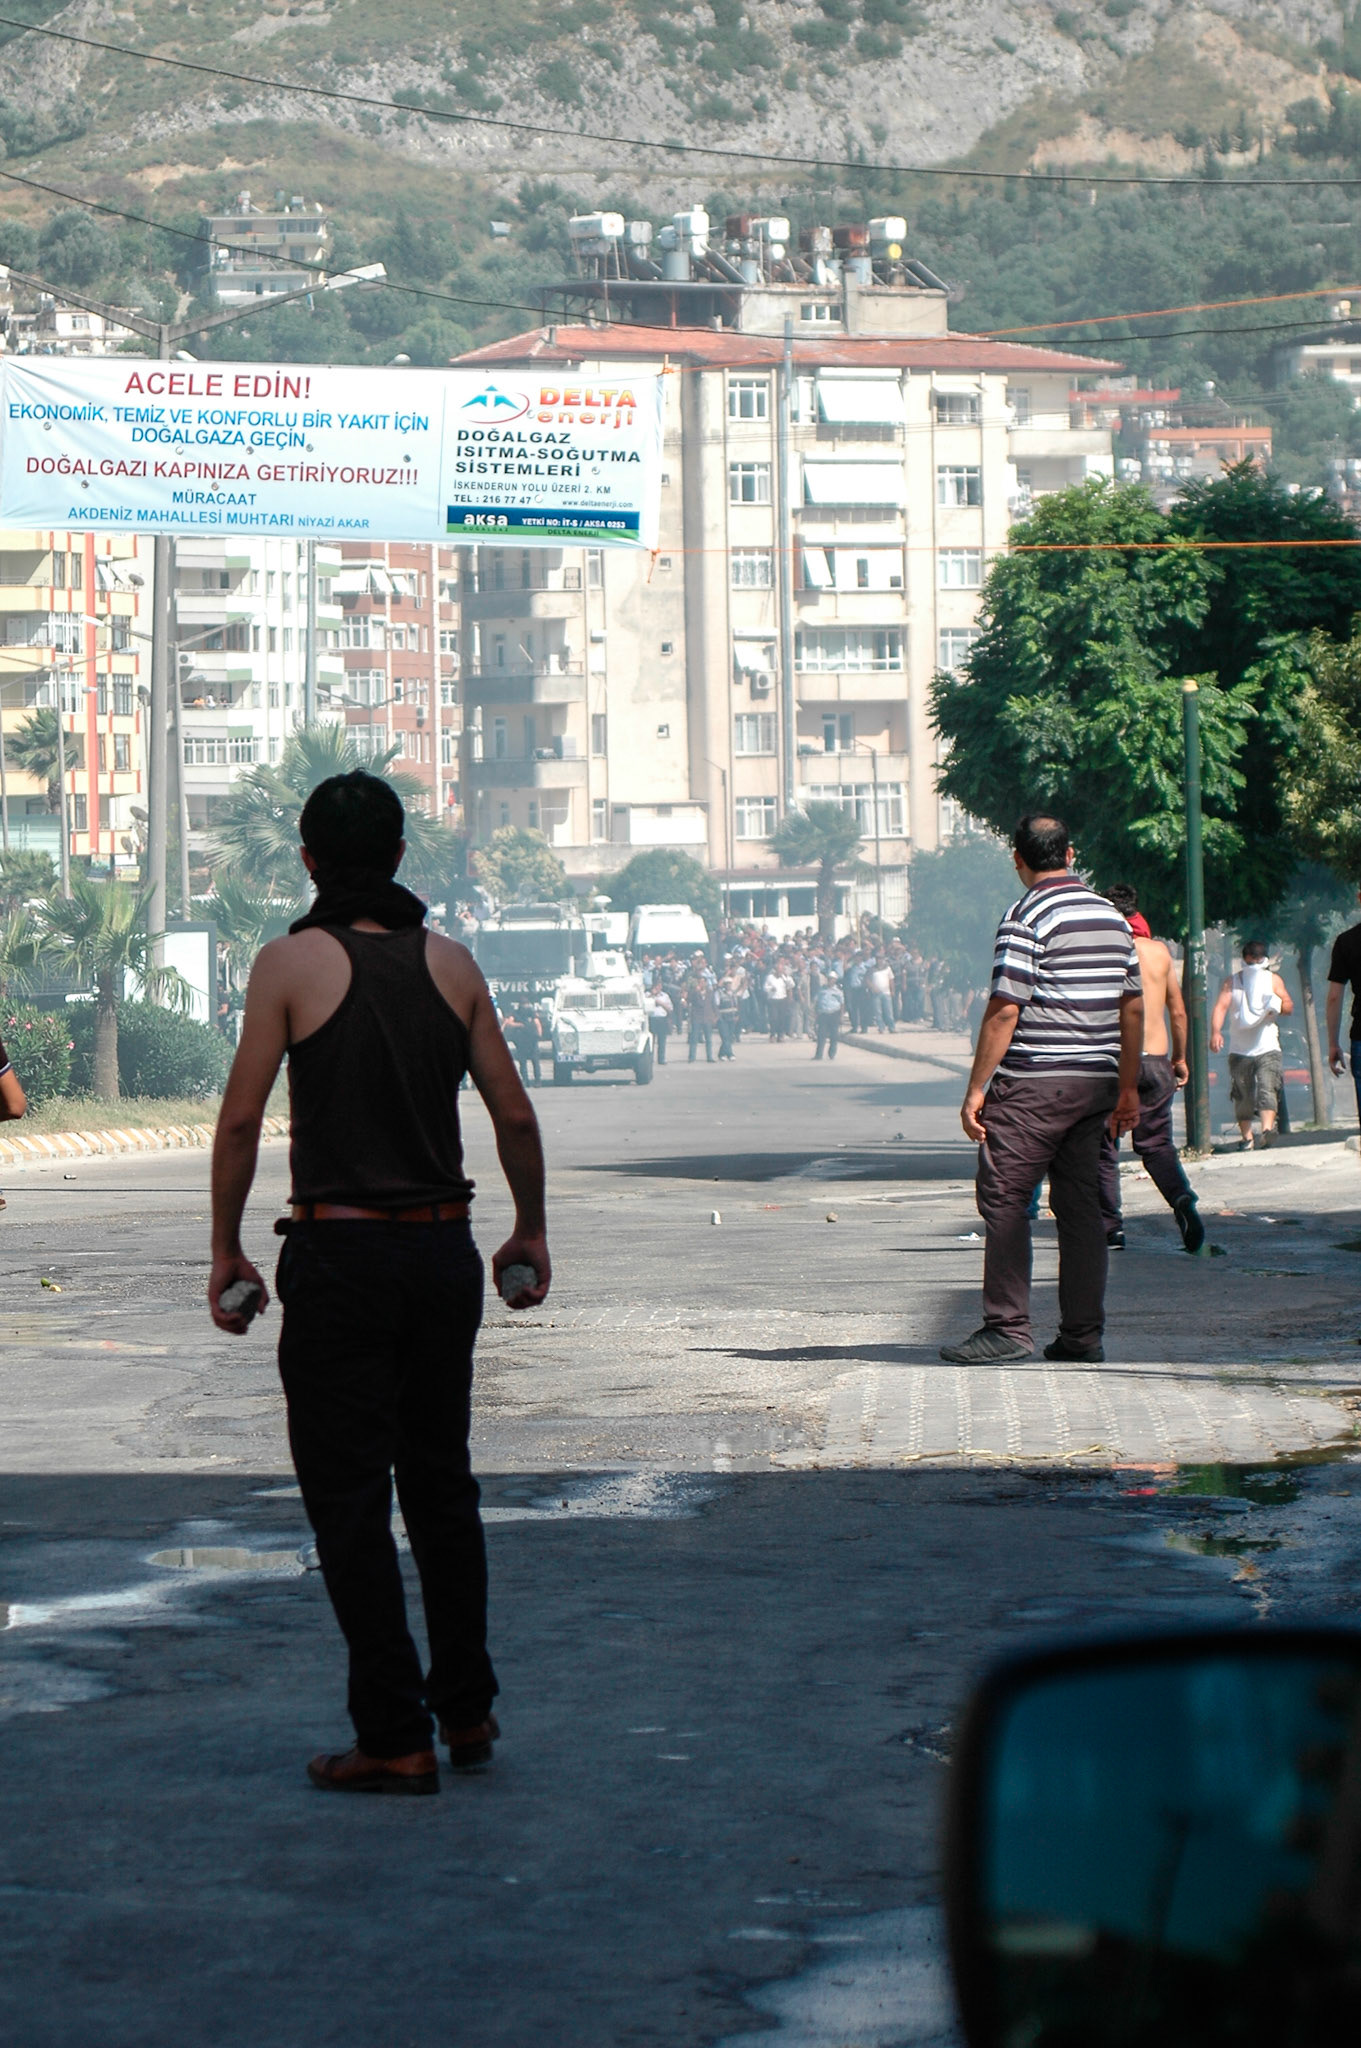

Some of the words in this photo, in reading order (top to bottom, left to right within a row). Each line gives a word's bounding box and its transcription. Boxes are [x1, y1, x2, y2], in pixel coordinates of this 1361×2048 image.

[124, 372, 223, 396] ACELE
[233, 371, 310, 399] EDİN!
[539, 387, 637, 408] DELTA
[9, 402, 108, 423] EKONOMİK,
[113, 404, 165, 423] TEMİZ
[170, 409, 192, 424] VE
[197, 410, 297, 427] KONFORLU
[302, 410, 332, 428] BİR
[337, 413, 390, 430] YAKIT
[394, 412, 429, 434] İÇİN
[537, 410, 633, 429] enerji
[132, 424, 245, 445] DOĞALGAZA
[457, 428, 571, 444] DOĞALGAZ
[456, 445, 641, 462] ISITMA-SOĞUTMA
[26, 453, 146, 476] DOĞALGAZI
[154, 461, 250, 480] KAPINIZA
[257, 462, 418, 485] GETİRİYORUZ!!!
[455, 459, 580, 476] SİSTEMLERİ
[454, 480, 518, 492] İSKENDERUN
[521, 483, 548, 492] YOLU
[552, 482, 581, 493] ÜZERİ
[584, 485, 592, 493] 2.
[596, 486, 611, 494] KM
[172, 489, 257, 505] MÜRACAAT
[454, 494, 472, 503] TEL
[483, 495, 501, 504] 216
[505, 496, 516, 504] 77
[519, 496, 531, 504] 47
[562, 500, 633, 509] www.deltaenerji.com
[68, 505, 132, 521] AKDENİZ
[137, 508, 222, 524] MAHALLESİ
[227, 512, 293, 526] MUHTARI
[298, 516, 334, 527] NİYAZİ
[337, 519, 369, 528] AKAR
[464, 513, 508, 526] aksa
[522, 516, 545, 526] YETKİ
[584, 520, 605, 528] AKSA
